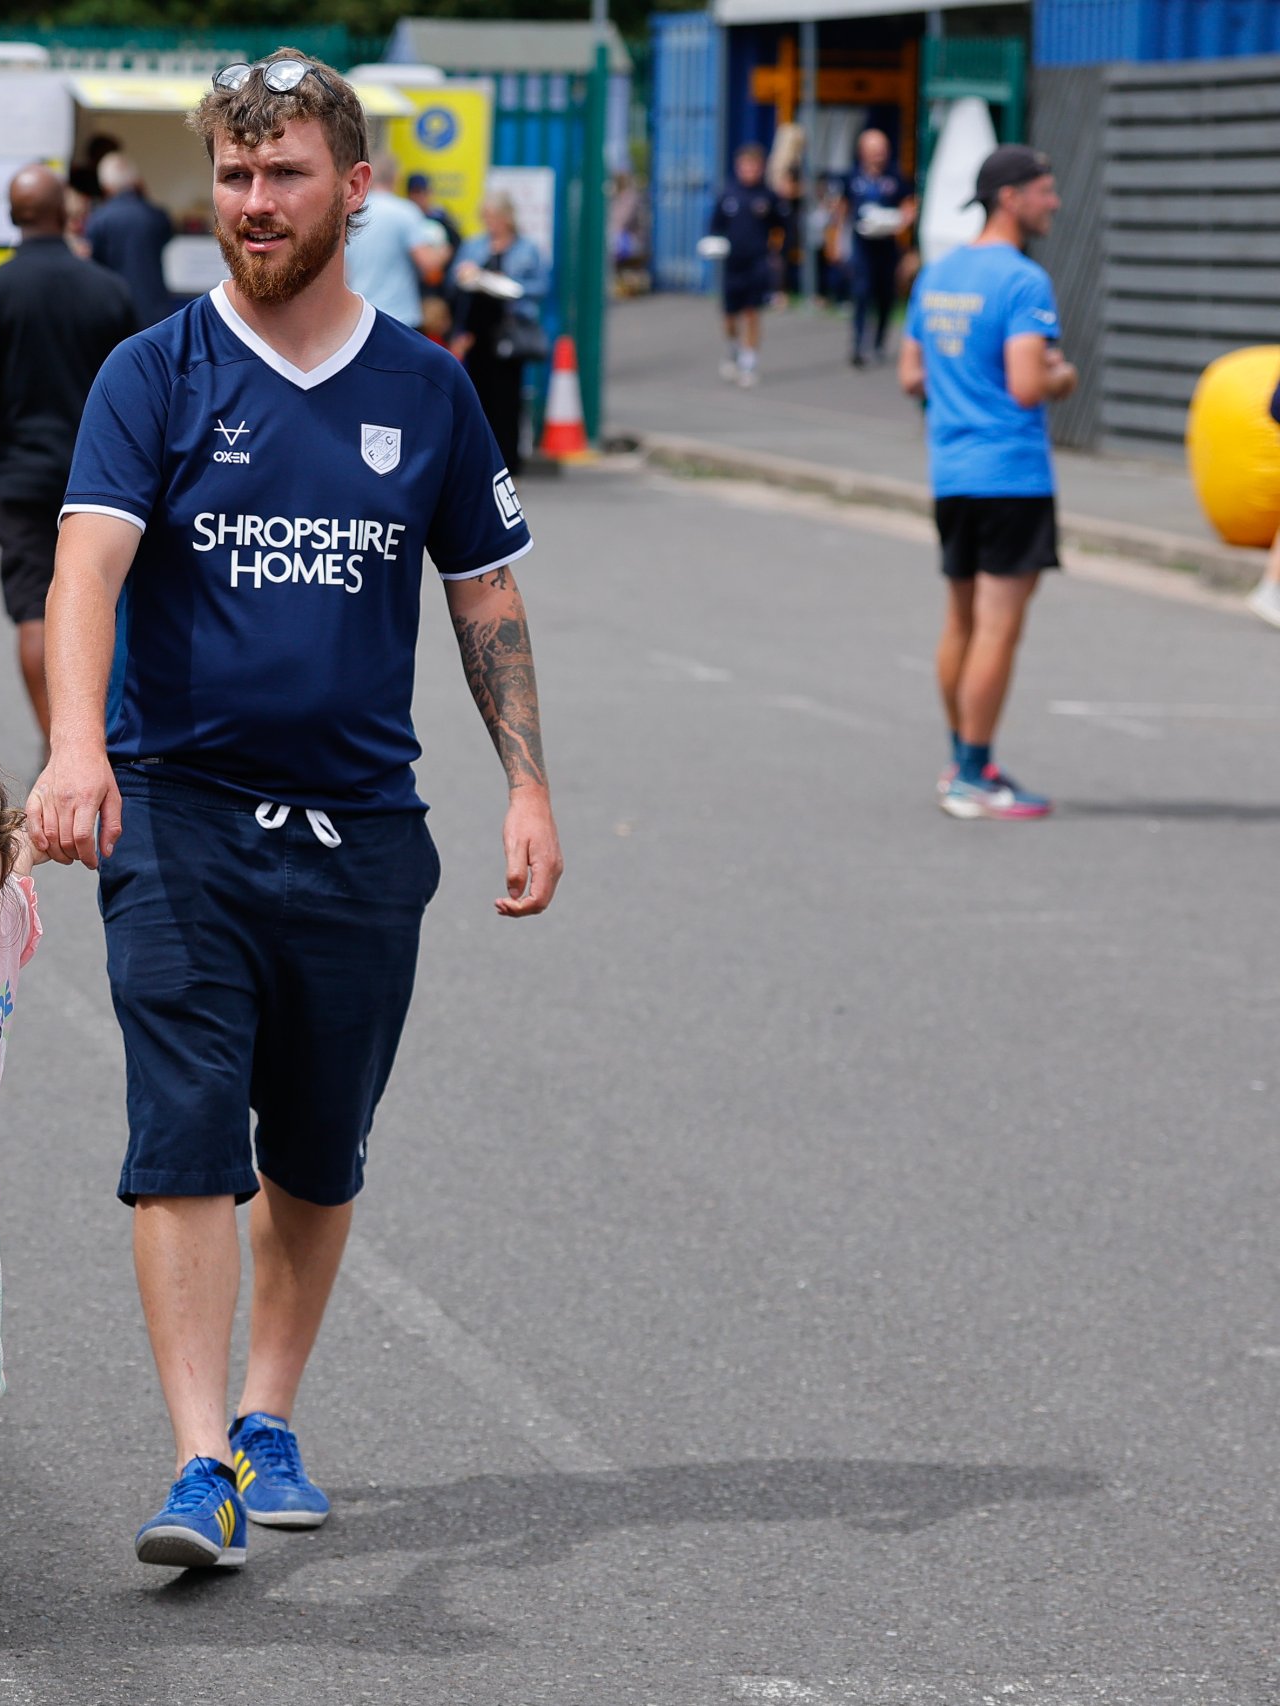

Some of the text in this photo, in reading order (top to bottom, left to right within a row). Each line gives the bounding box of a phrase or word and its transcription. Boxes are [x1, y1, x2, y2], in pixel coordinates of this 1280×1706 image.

[213, 451, 250, 464] OXEN
[192, 512, 406, 560] SHROPSHIRE
[230, 550, 363, 593] HOMES
